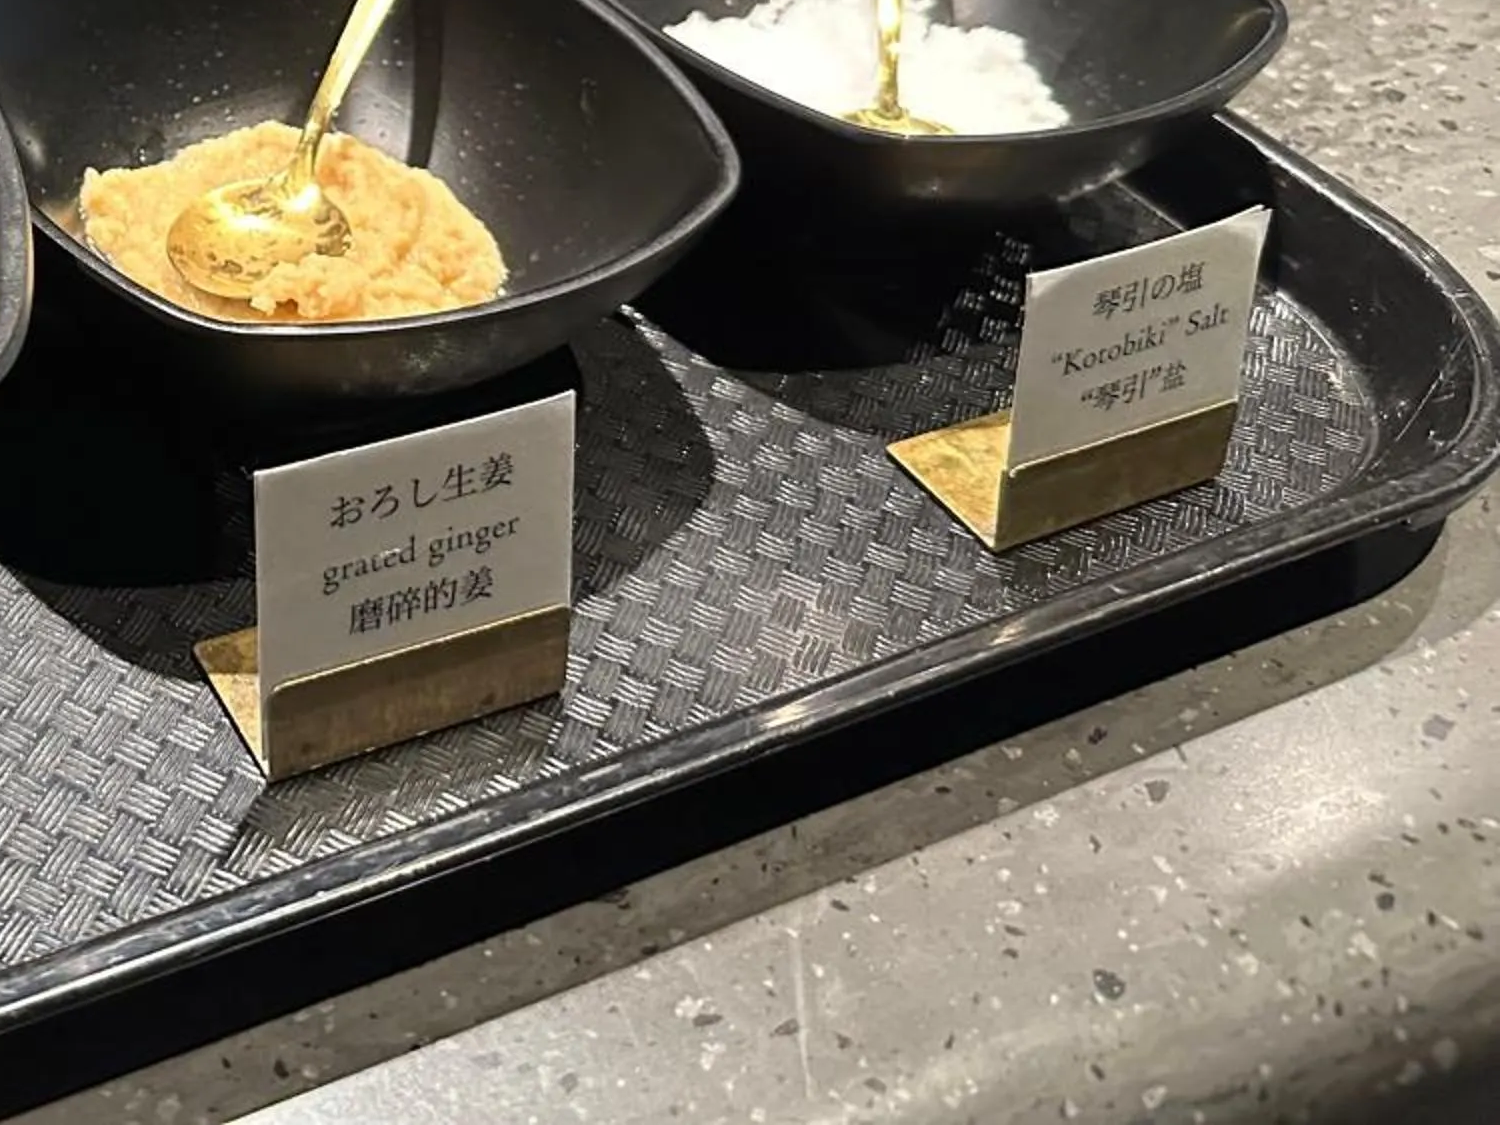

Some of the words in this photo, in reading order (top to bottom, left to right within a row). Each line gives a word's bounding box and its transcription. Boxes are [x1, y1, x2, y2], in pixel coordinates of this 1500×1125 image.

[1091, 261, 1206, 320] 琴引の塩
[1184, 303, 1231, 337] Salt
[329, 452, 515, 528] おろし生姜
[321, 535, 417, 595] grated
[427, 517, 520, 568] ginger
[349, 565, 494, 636] 磨碎的姜
